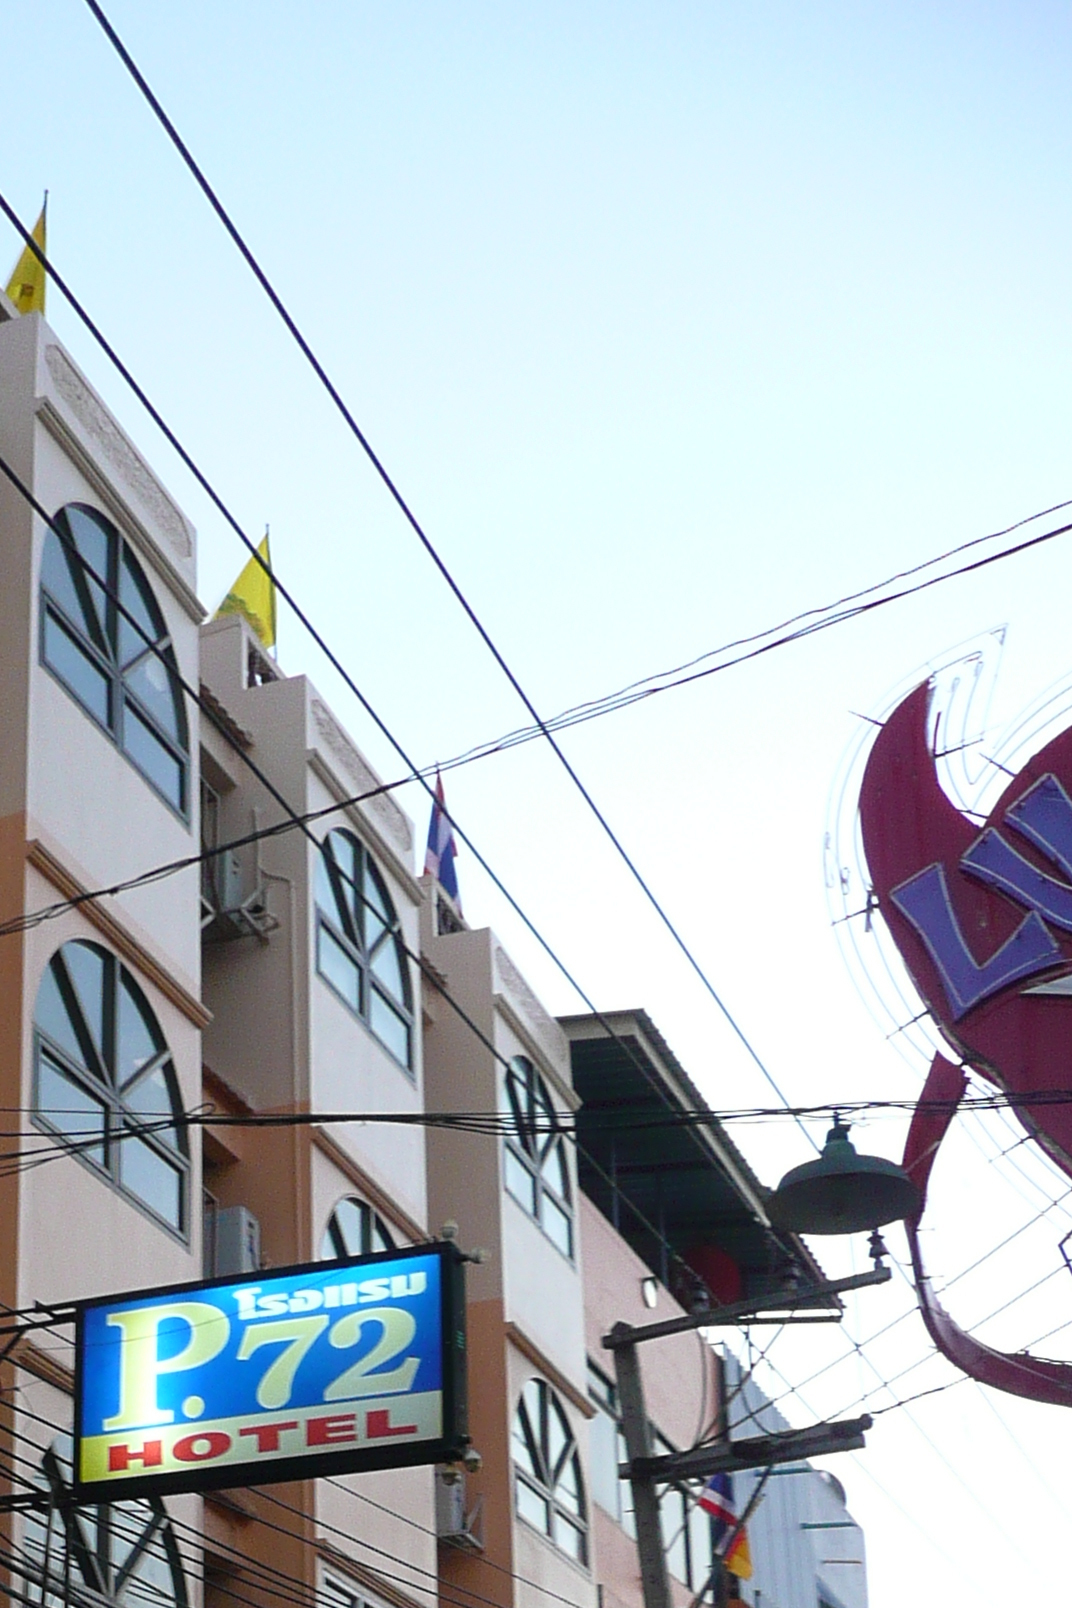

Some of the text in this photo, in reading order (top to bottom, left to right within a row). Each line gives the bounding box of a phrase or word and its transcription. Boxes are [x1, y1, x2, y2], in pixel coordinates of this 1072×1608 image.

[233, 1271, 427, 1321] โรงแรม
[108, 1409, 418, 1472] HOTEL
